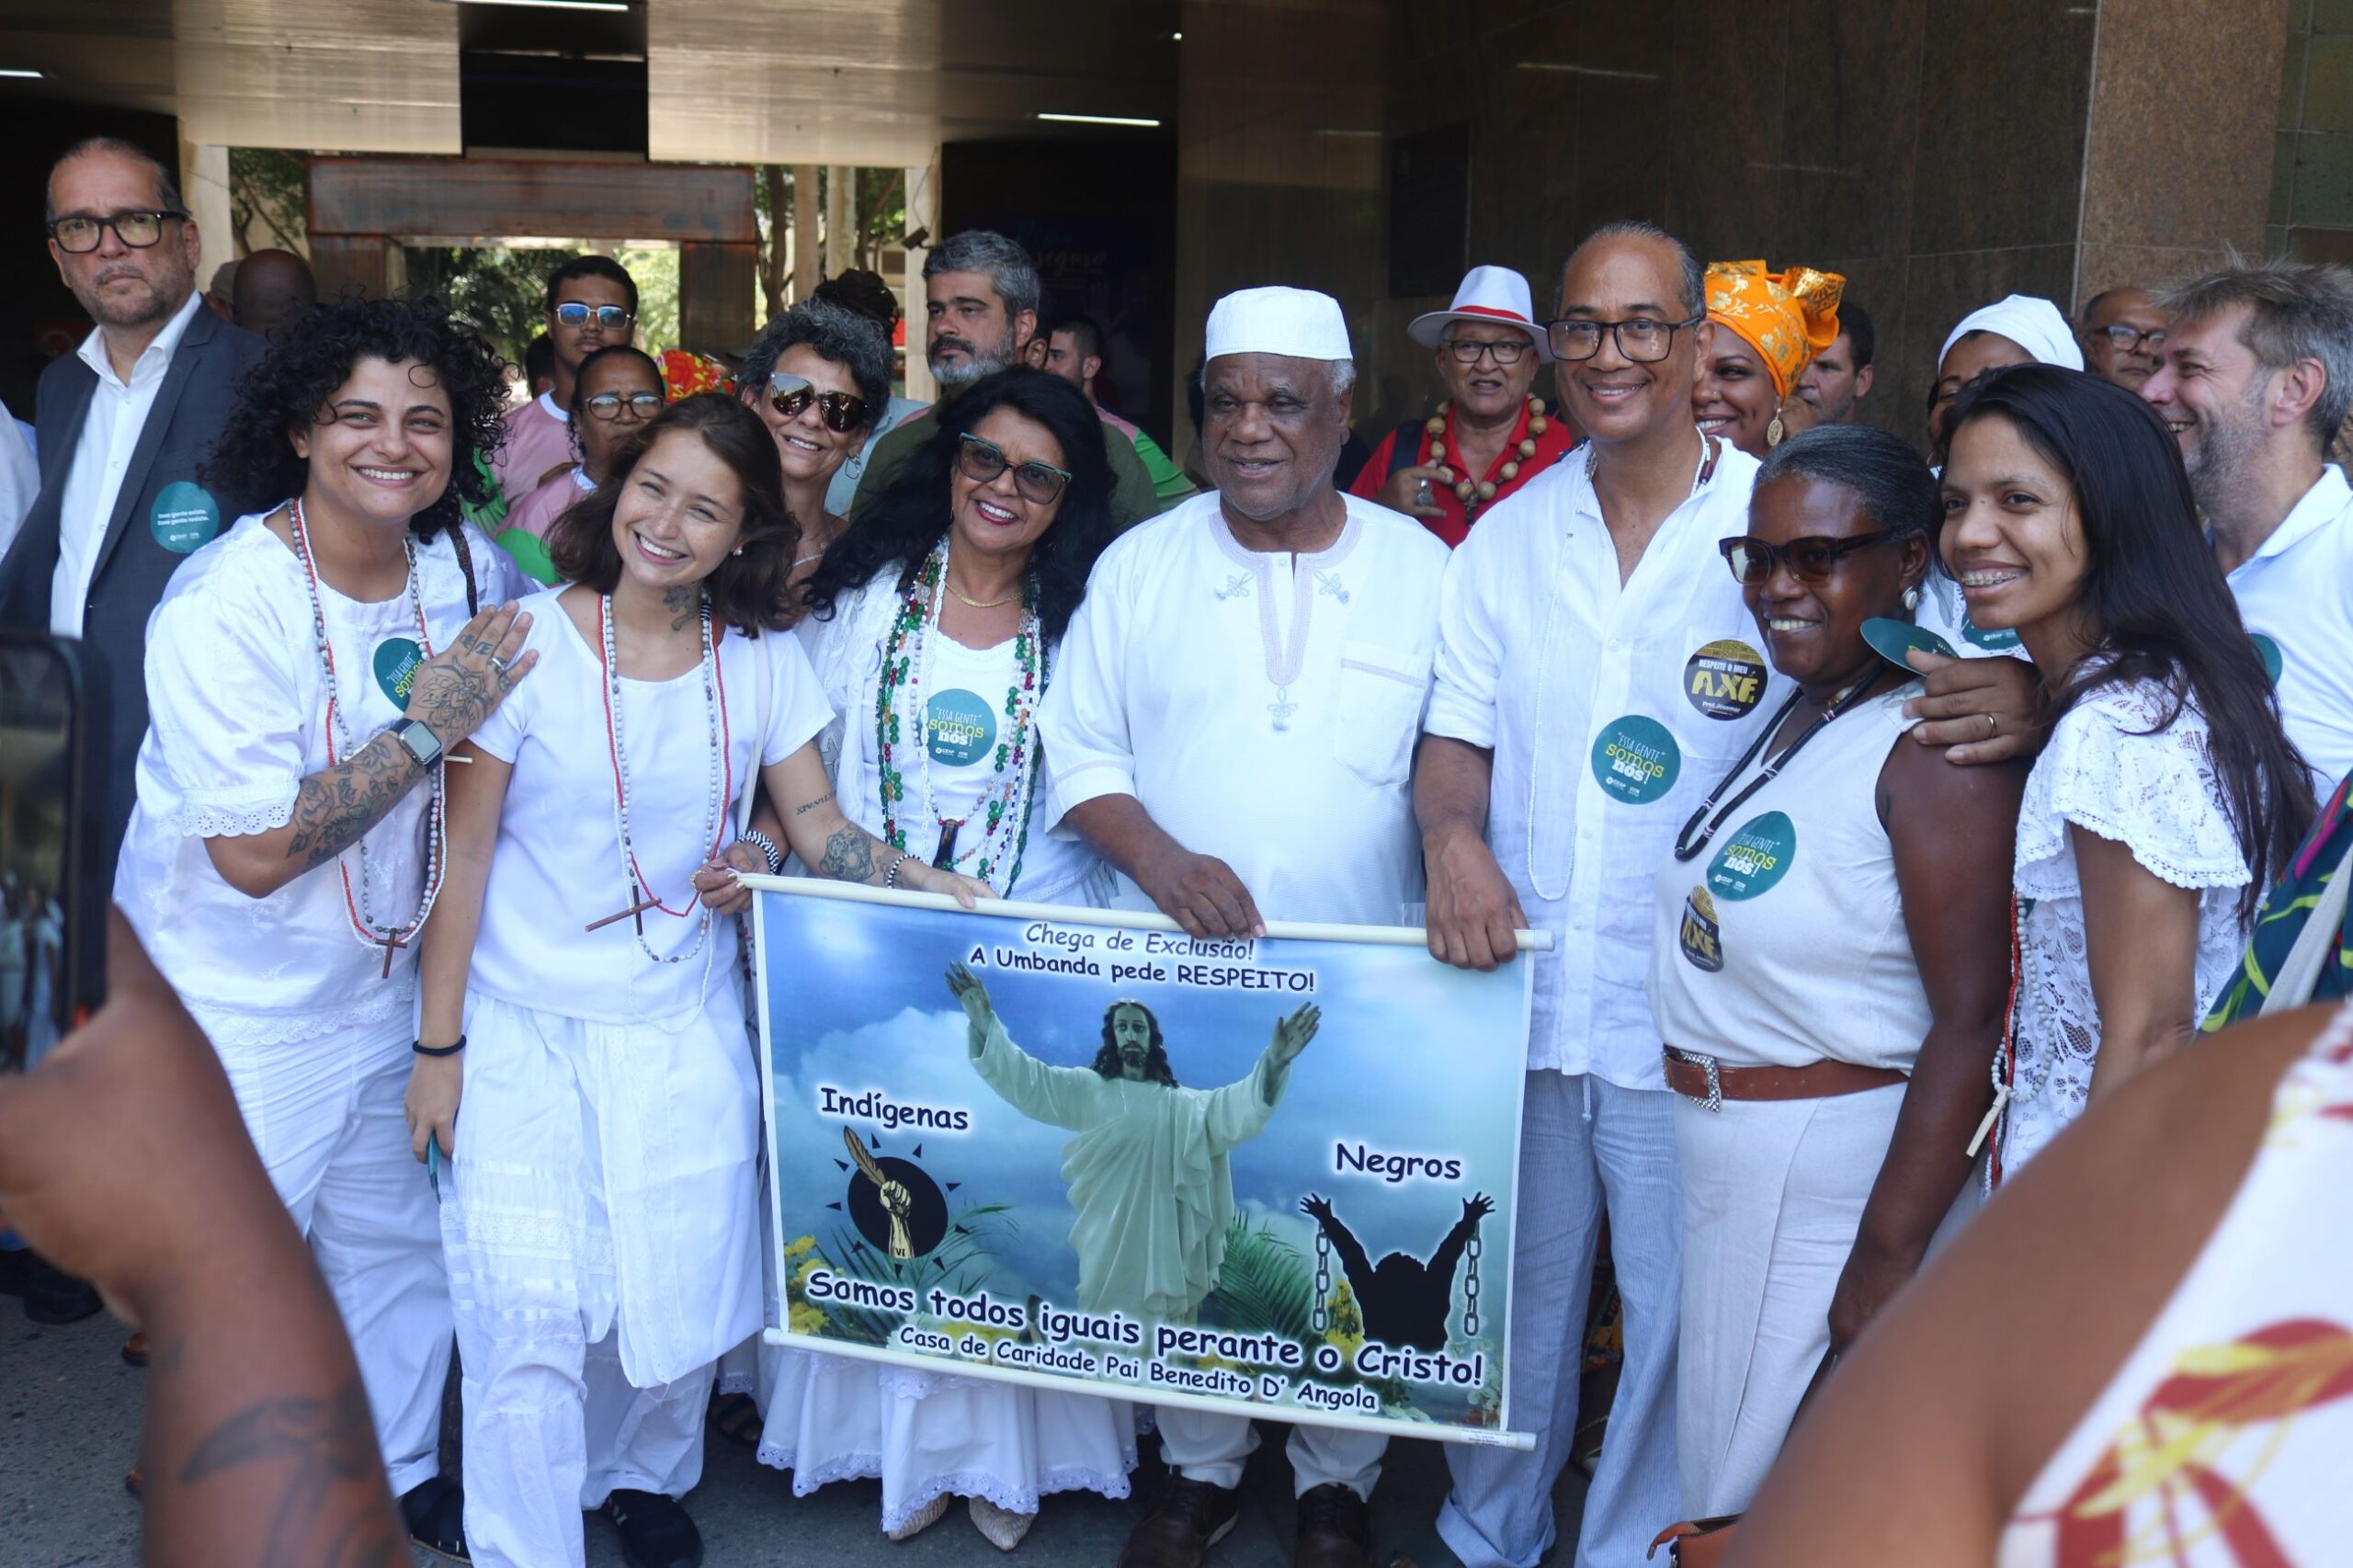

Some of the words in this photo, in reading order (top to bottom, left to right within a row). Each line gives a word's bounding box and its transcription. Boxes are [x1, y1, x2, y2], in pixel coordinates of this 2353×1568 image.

[1699, 659, 1726, 671] RESPEITE
[1733, 664, 1748, 675] MEU
[928, 719, 984, 738] somos
[1605, 743, 1665, 778] somos
[1724, 844, 1777, 870] somos
[1026, 924, 1095, 952] Chega
[1107, 931, 1132, 951] de
[1145, 934, 1255, 960] Exclusão!
[971, 948, 986, 966] A
[996, 949, 1099, 976] Umbanda
[1111, 960, 1166, 983] pede
[1178, 967, 1315, 993] RESPEITO!
[821, 1087, 968, 1131] Indígenas
[1336, 1142, 1461, 1183] Negros
[808, 1272, 915, 1312] Somos
[930, 1290, 1024, 1327] todos
[1041, 1304, 1140, 1345] iguais
[1157, 1326, 1301, 1365] perante
[1318, 1348, 1339, 1369] o
[1358, 1346, 1483, 1387] Cristo!
[900, 1327, 950, 1351] Casa
[961, 1335, 987, 1356] de
[997, 1342, 1096, 1372] Caridade
[1107, 1356, 1139, 1379] Pai
[1151, 1362, 1252, 1394] Benedito
[1298, 1383, 1376, 1412] Angola
